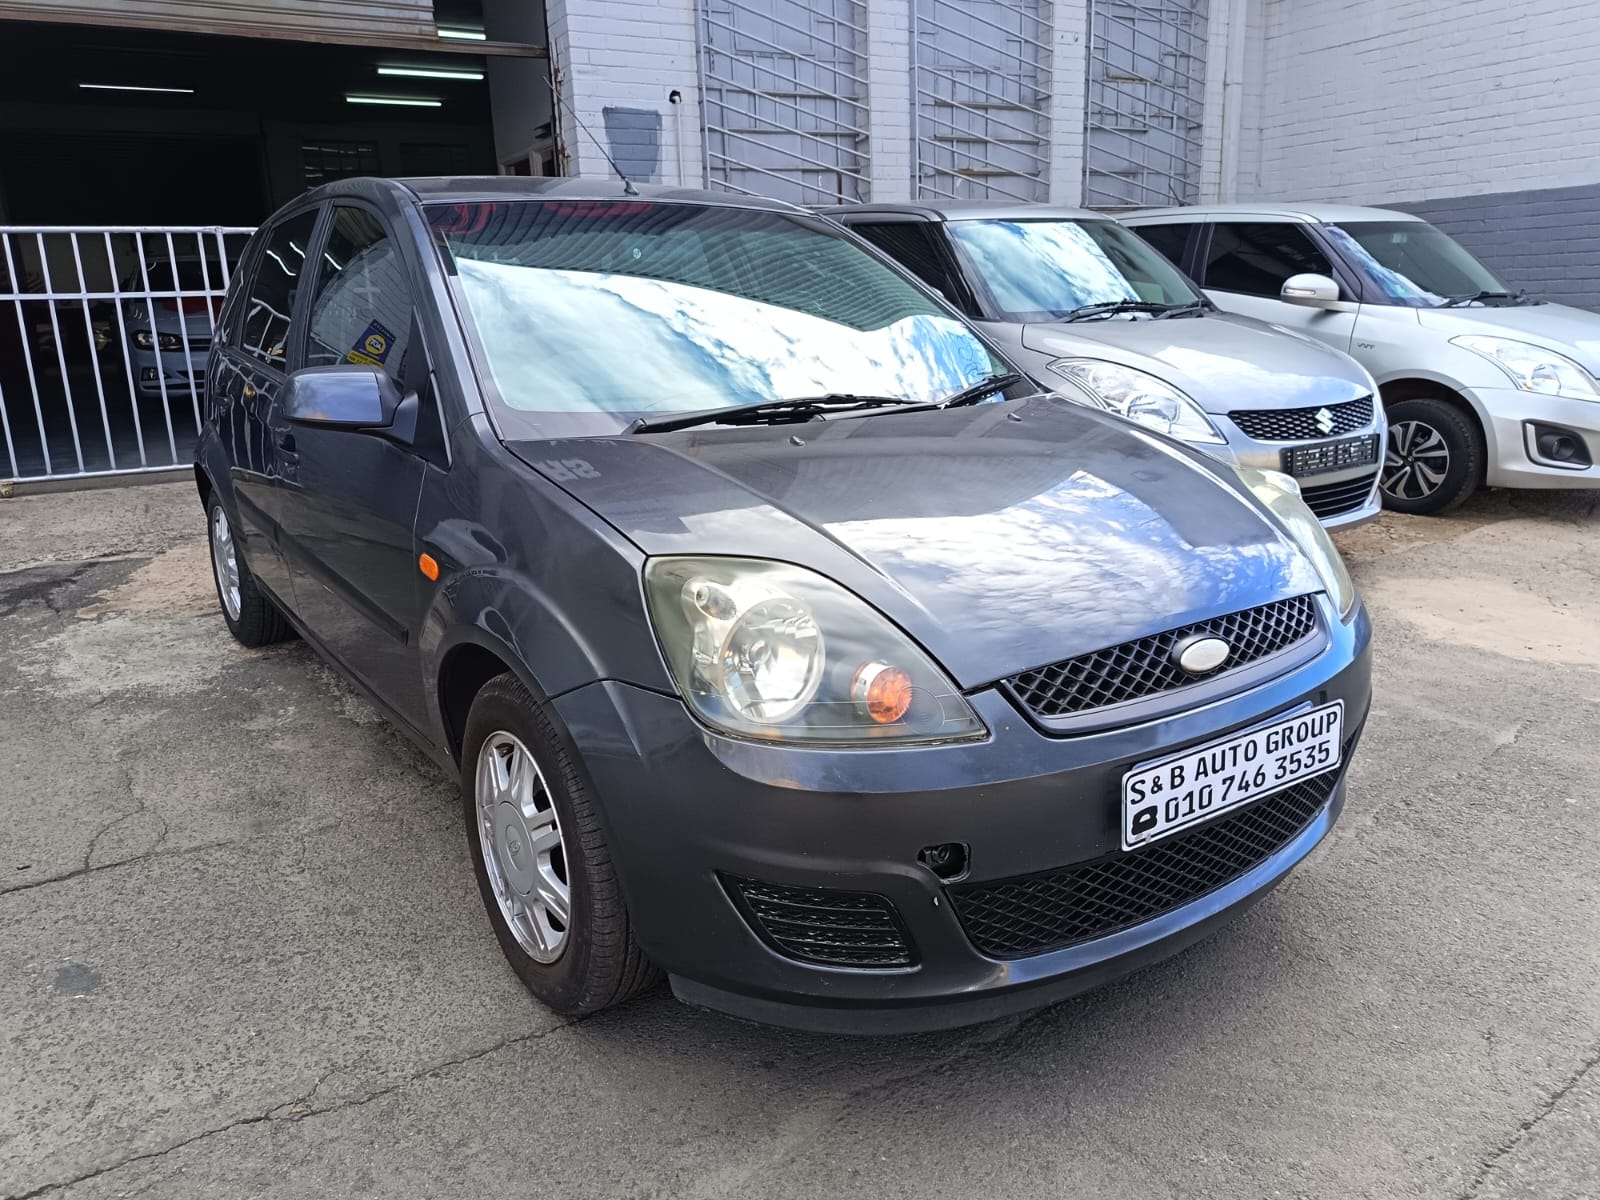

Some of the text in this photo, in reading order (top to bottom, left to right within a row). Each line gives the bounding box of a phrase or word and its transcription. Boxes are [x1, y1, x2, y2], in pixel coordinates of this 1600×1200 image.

[1164, 739, 1331, 824] 010 746 3535
[1194, 739, 1257, 780] AUTO
[1266, 711, 1338, 754] GROUP
